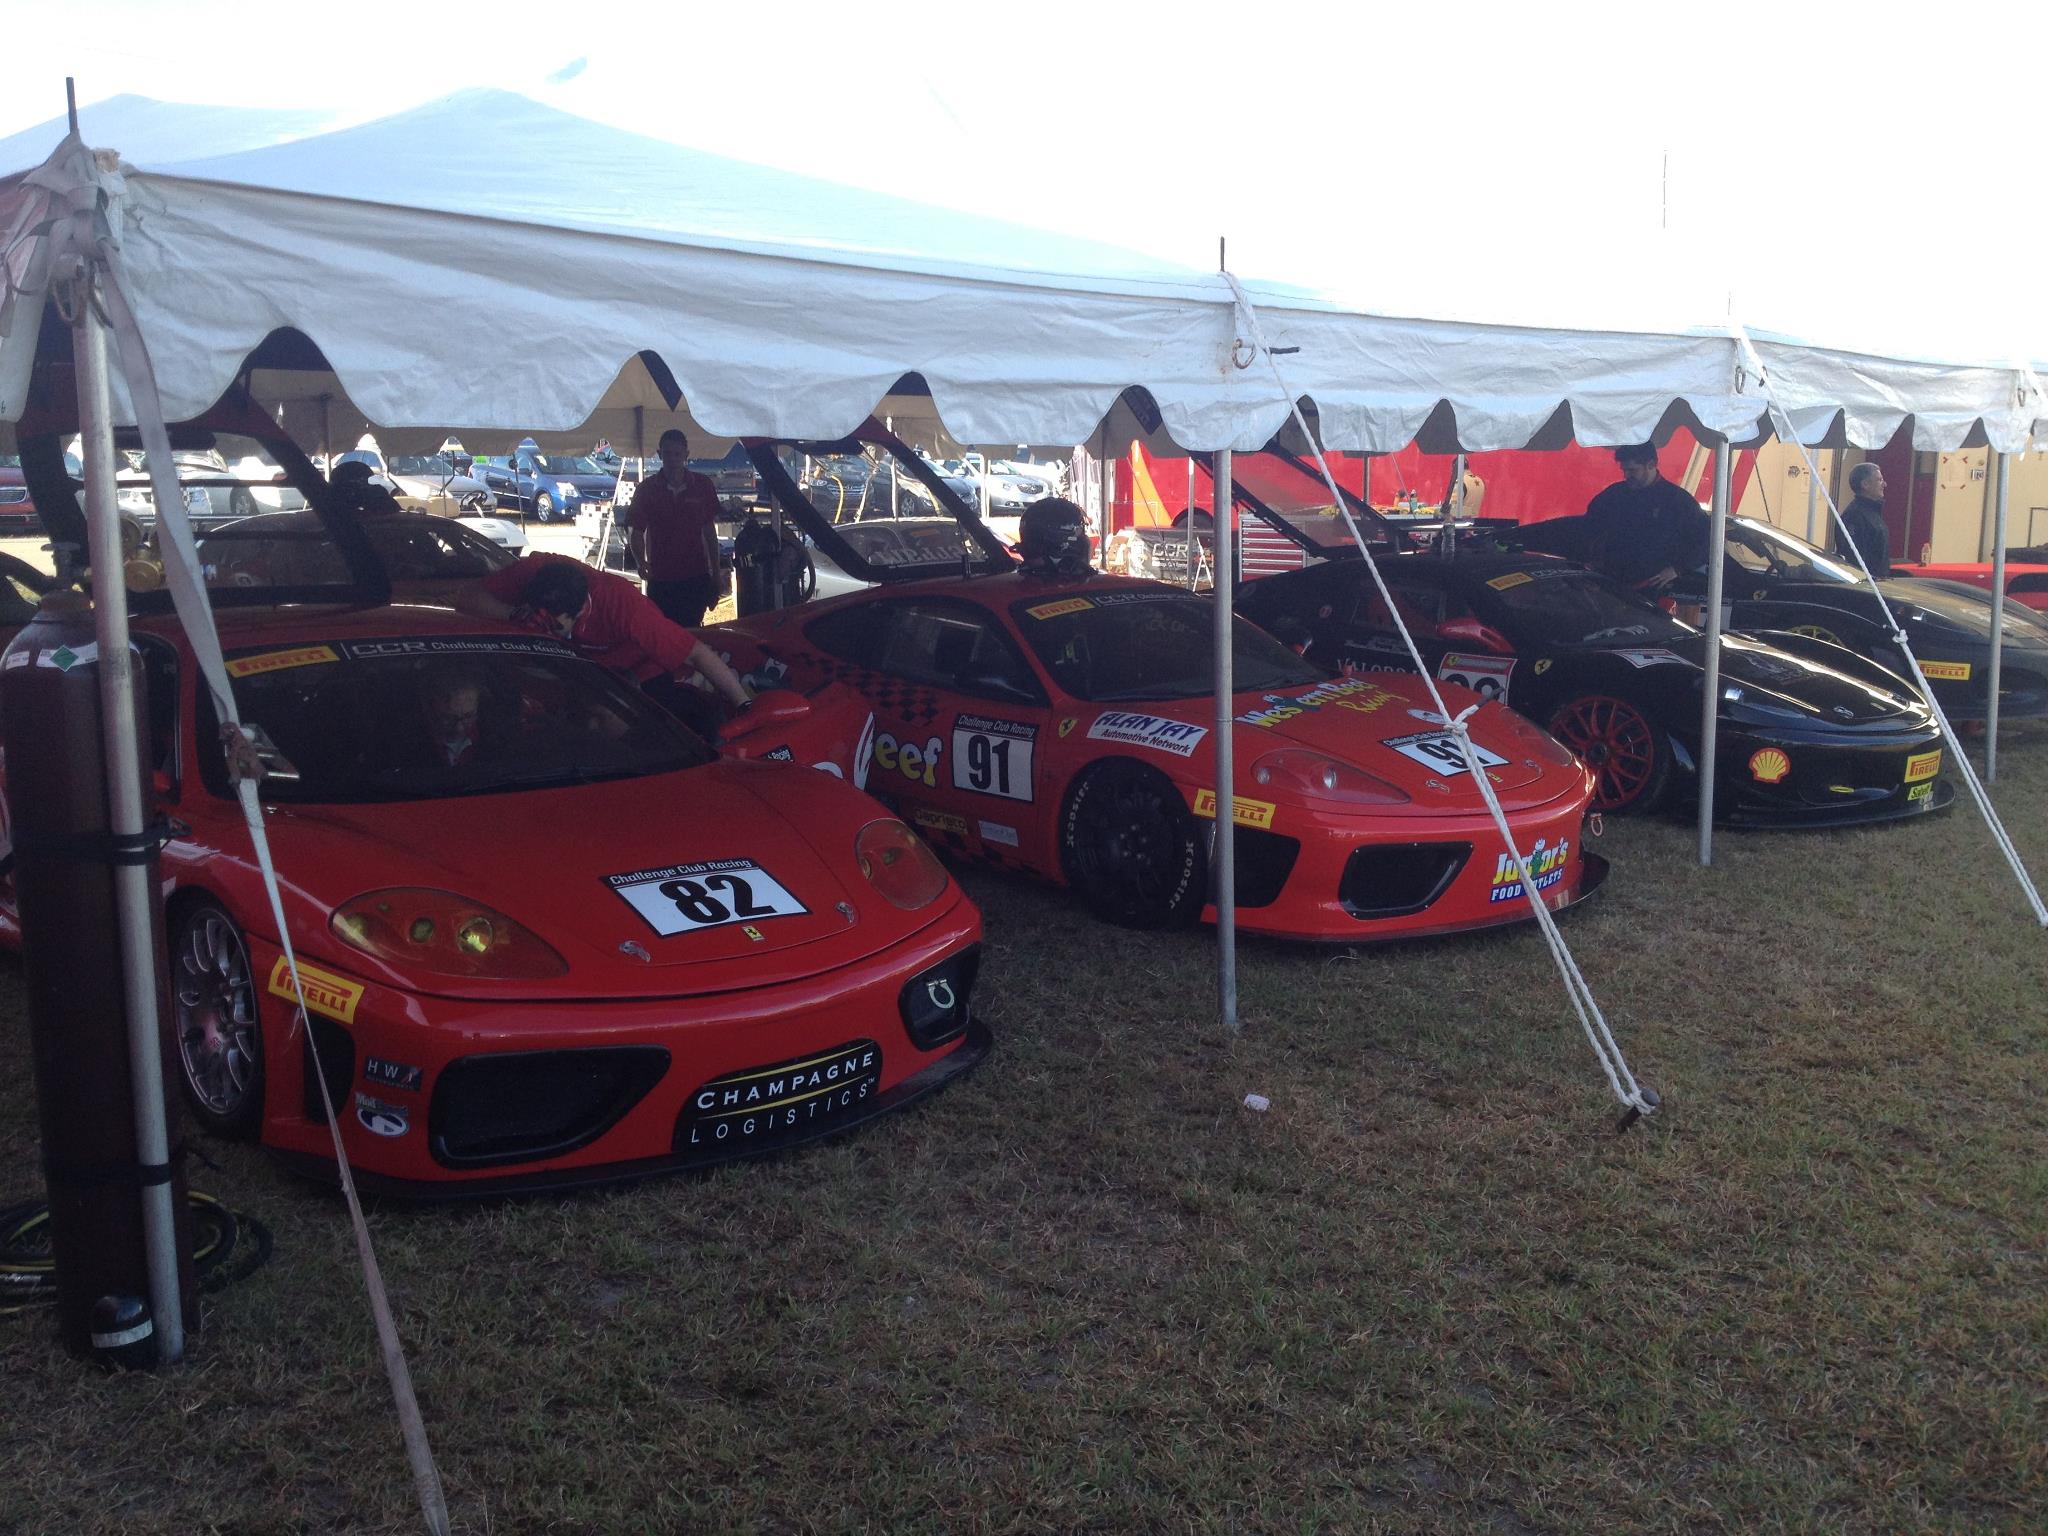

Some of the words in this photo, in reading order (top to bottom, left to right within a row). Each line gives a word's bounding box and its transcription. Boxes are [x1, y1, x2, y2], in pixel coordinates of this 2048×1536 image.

[1152, 542, 1188, 557] CCR
[233, 650, 327, 673] PIRELLI
[352, 642, 428, 656] CCR
[431, 641, 498, 651] Challenge
[502, 642, 531, 652] Club
[532, 644, 577, 657] Racing
[958, 715, 993, 730] Challenge
[993, 720, 1010, 732] Club
[1010, 723, 1035, 738] Racing
[1095, 713, 1159, 731] ALAN
[1149, 720, 1202, 740] JAY
[1101, 729, 1149, 743] Automotive
[1150, 736, 1191, 753] Network
[968, 734, 1010, 794] 91
[1910, 756, 1939, 777] PIRELLI
[1200, 795, 1268, 823] PIELLI
[609, 868, 677, 886] Challenge
[677, 862, 708, 875] Club
[708, 858, 753, 872] Racing
[658, 873, 778, 924] 82
[1491, 884, 1522, 901] FOOD
[697, 1052, 874, 1110] CHAMPAGNE
[690, 1082, 868, 1144] LOGISTICS
